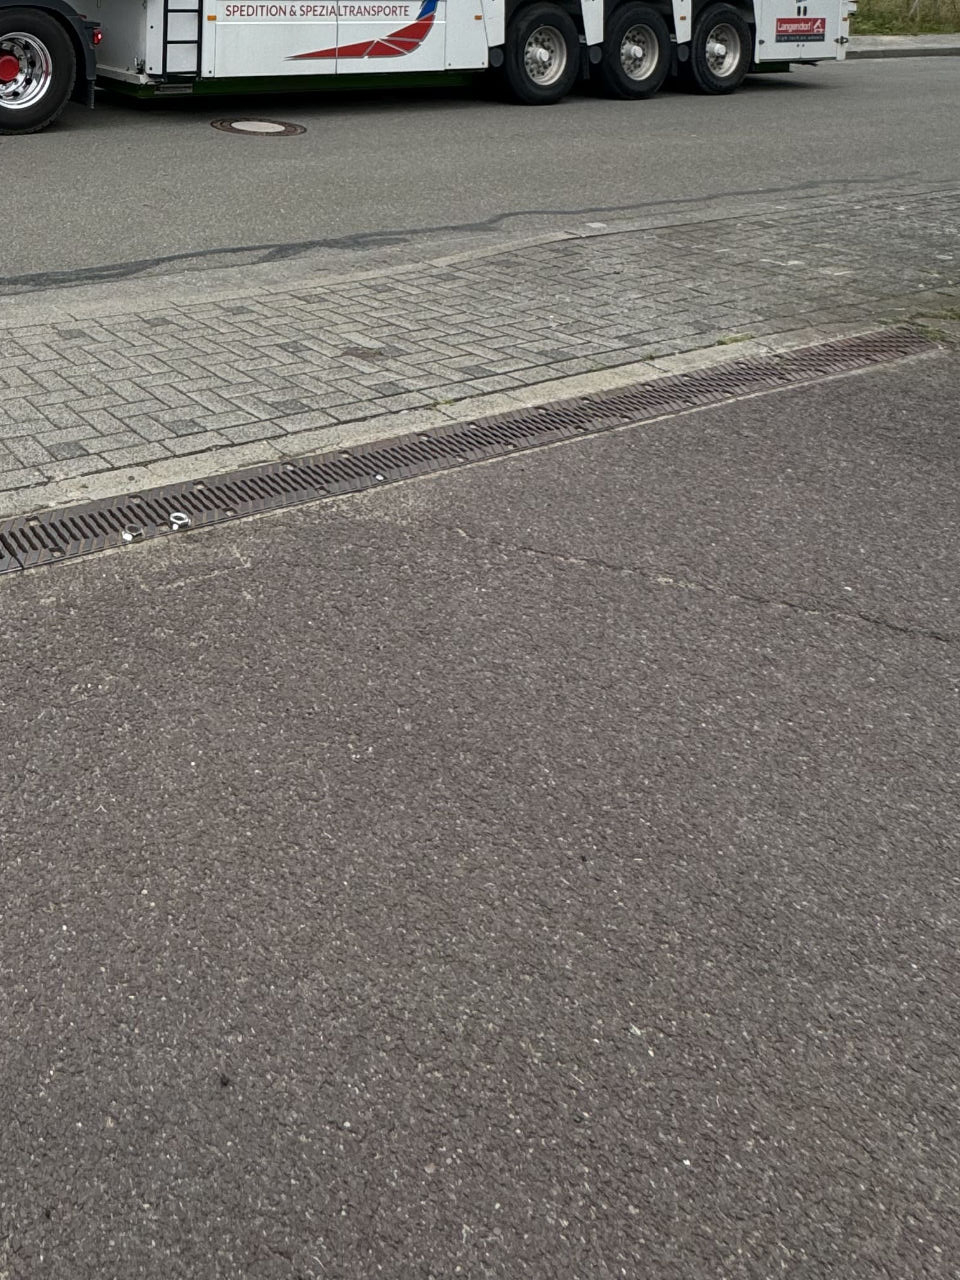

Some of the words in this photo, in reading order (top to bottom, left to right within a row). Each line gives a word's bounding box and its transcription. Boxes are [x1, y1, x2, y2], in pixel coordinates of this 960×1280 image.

[225, 4, 287, 17] SPEDITION
[290, 5, 297, 17] &
[300, 5, 410, 17] SPEZIALTRANSPORTE
